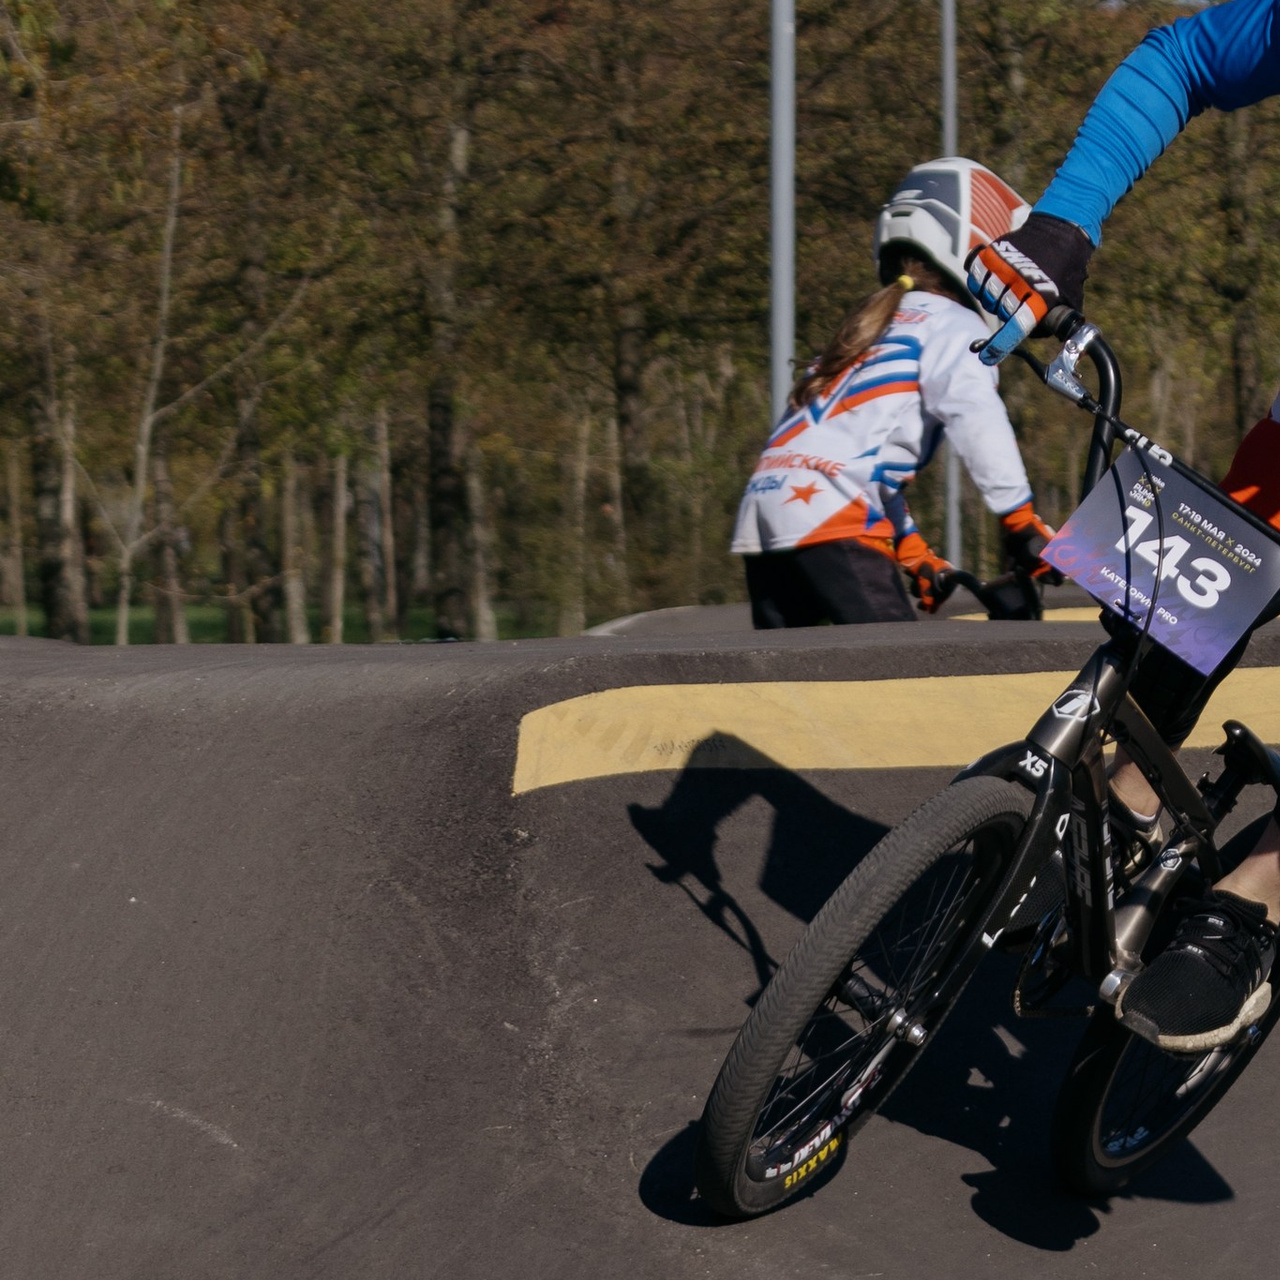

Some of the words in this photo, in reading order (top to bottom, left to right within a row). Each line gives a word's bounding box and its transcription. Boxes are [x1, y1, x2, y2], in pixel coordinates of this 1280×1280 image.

[1114, 506, 1231, 609] 143
[1172, 512, 1256, 573] САНКТ-ПЕТЕРБУРГ
[1201, 518, 1226, 541] МАЯ
[1235, 543, 1262, 567] 2024
[1101, 566, 1156, 609] КАТЕОРИ
[1157, 607, 1178, 625] PRO
[1018, 750, 1049, 777] X5
[784, 1132, 843, 1189] MAXXIS
